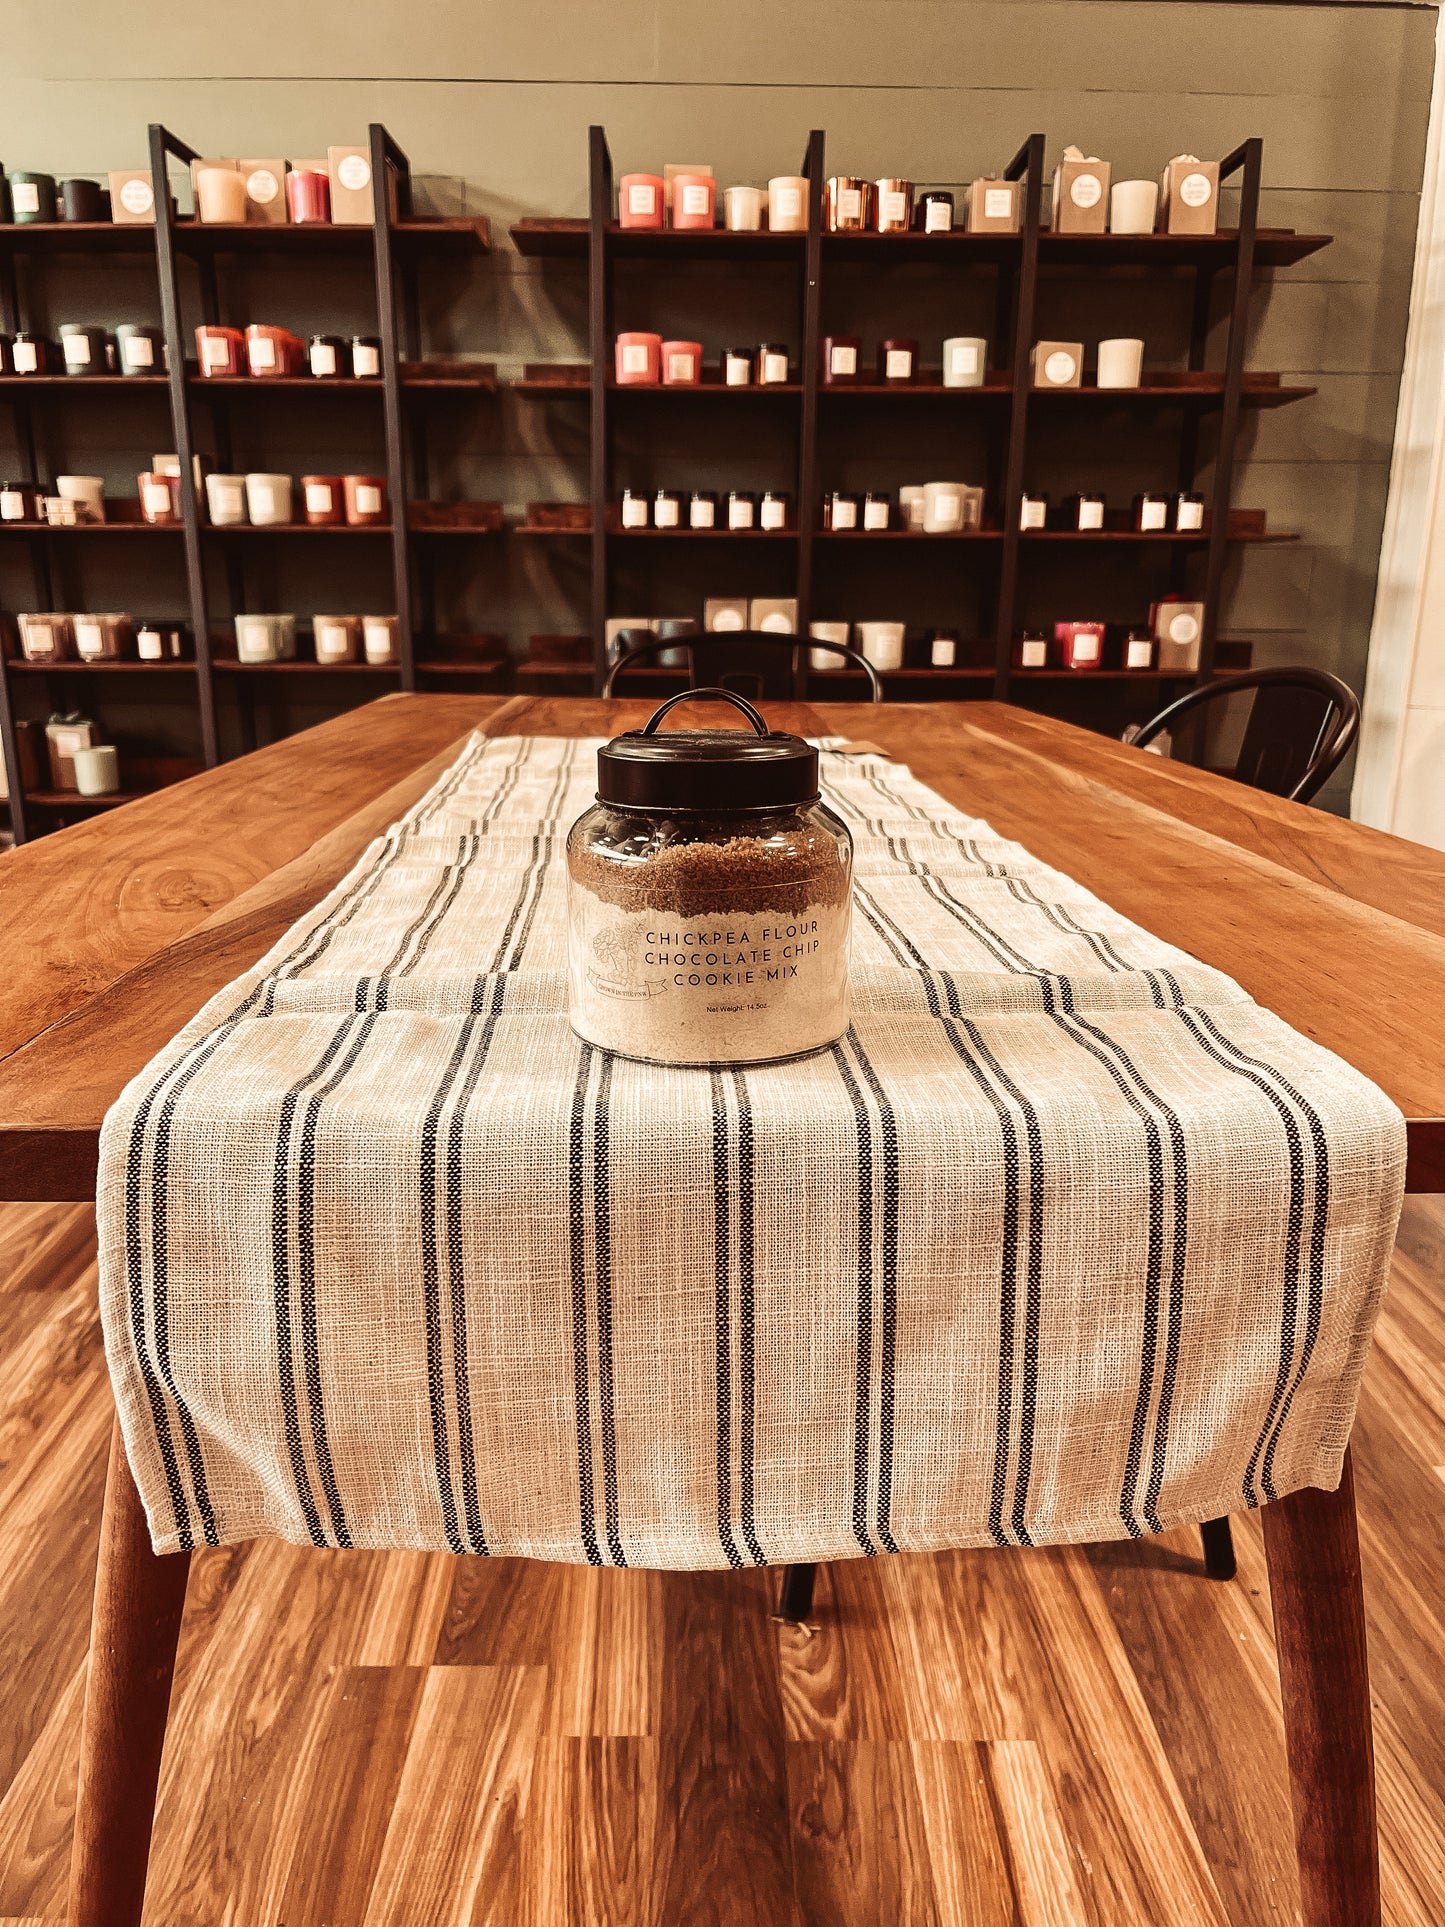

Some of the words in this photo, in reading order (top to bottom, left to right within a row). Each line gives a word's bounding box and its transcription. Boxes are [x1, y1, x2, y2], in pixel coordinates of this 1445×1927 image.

[646, 931, 750, 946] CHICKPEA
[763, 920, 818, 941] FLOUR
[644, 949, 771, 966] CHOCOLATE
[783, 940, 819, 958] CHIP
[673, 971, 754, 986] COOKIE
[767, 965, 798, 981] MIX
